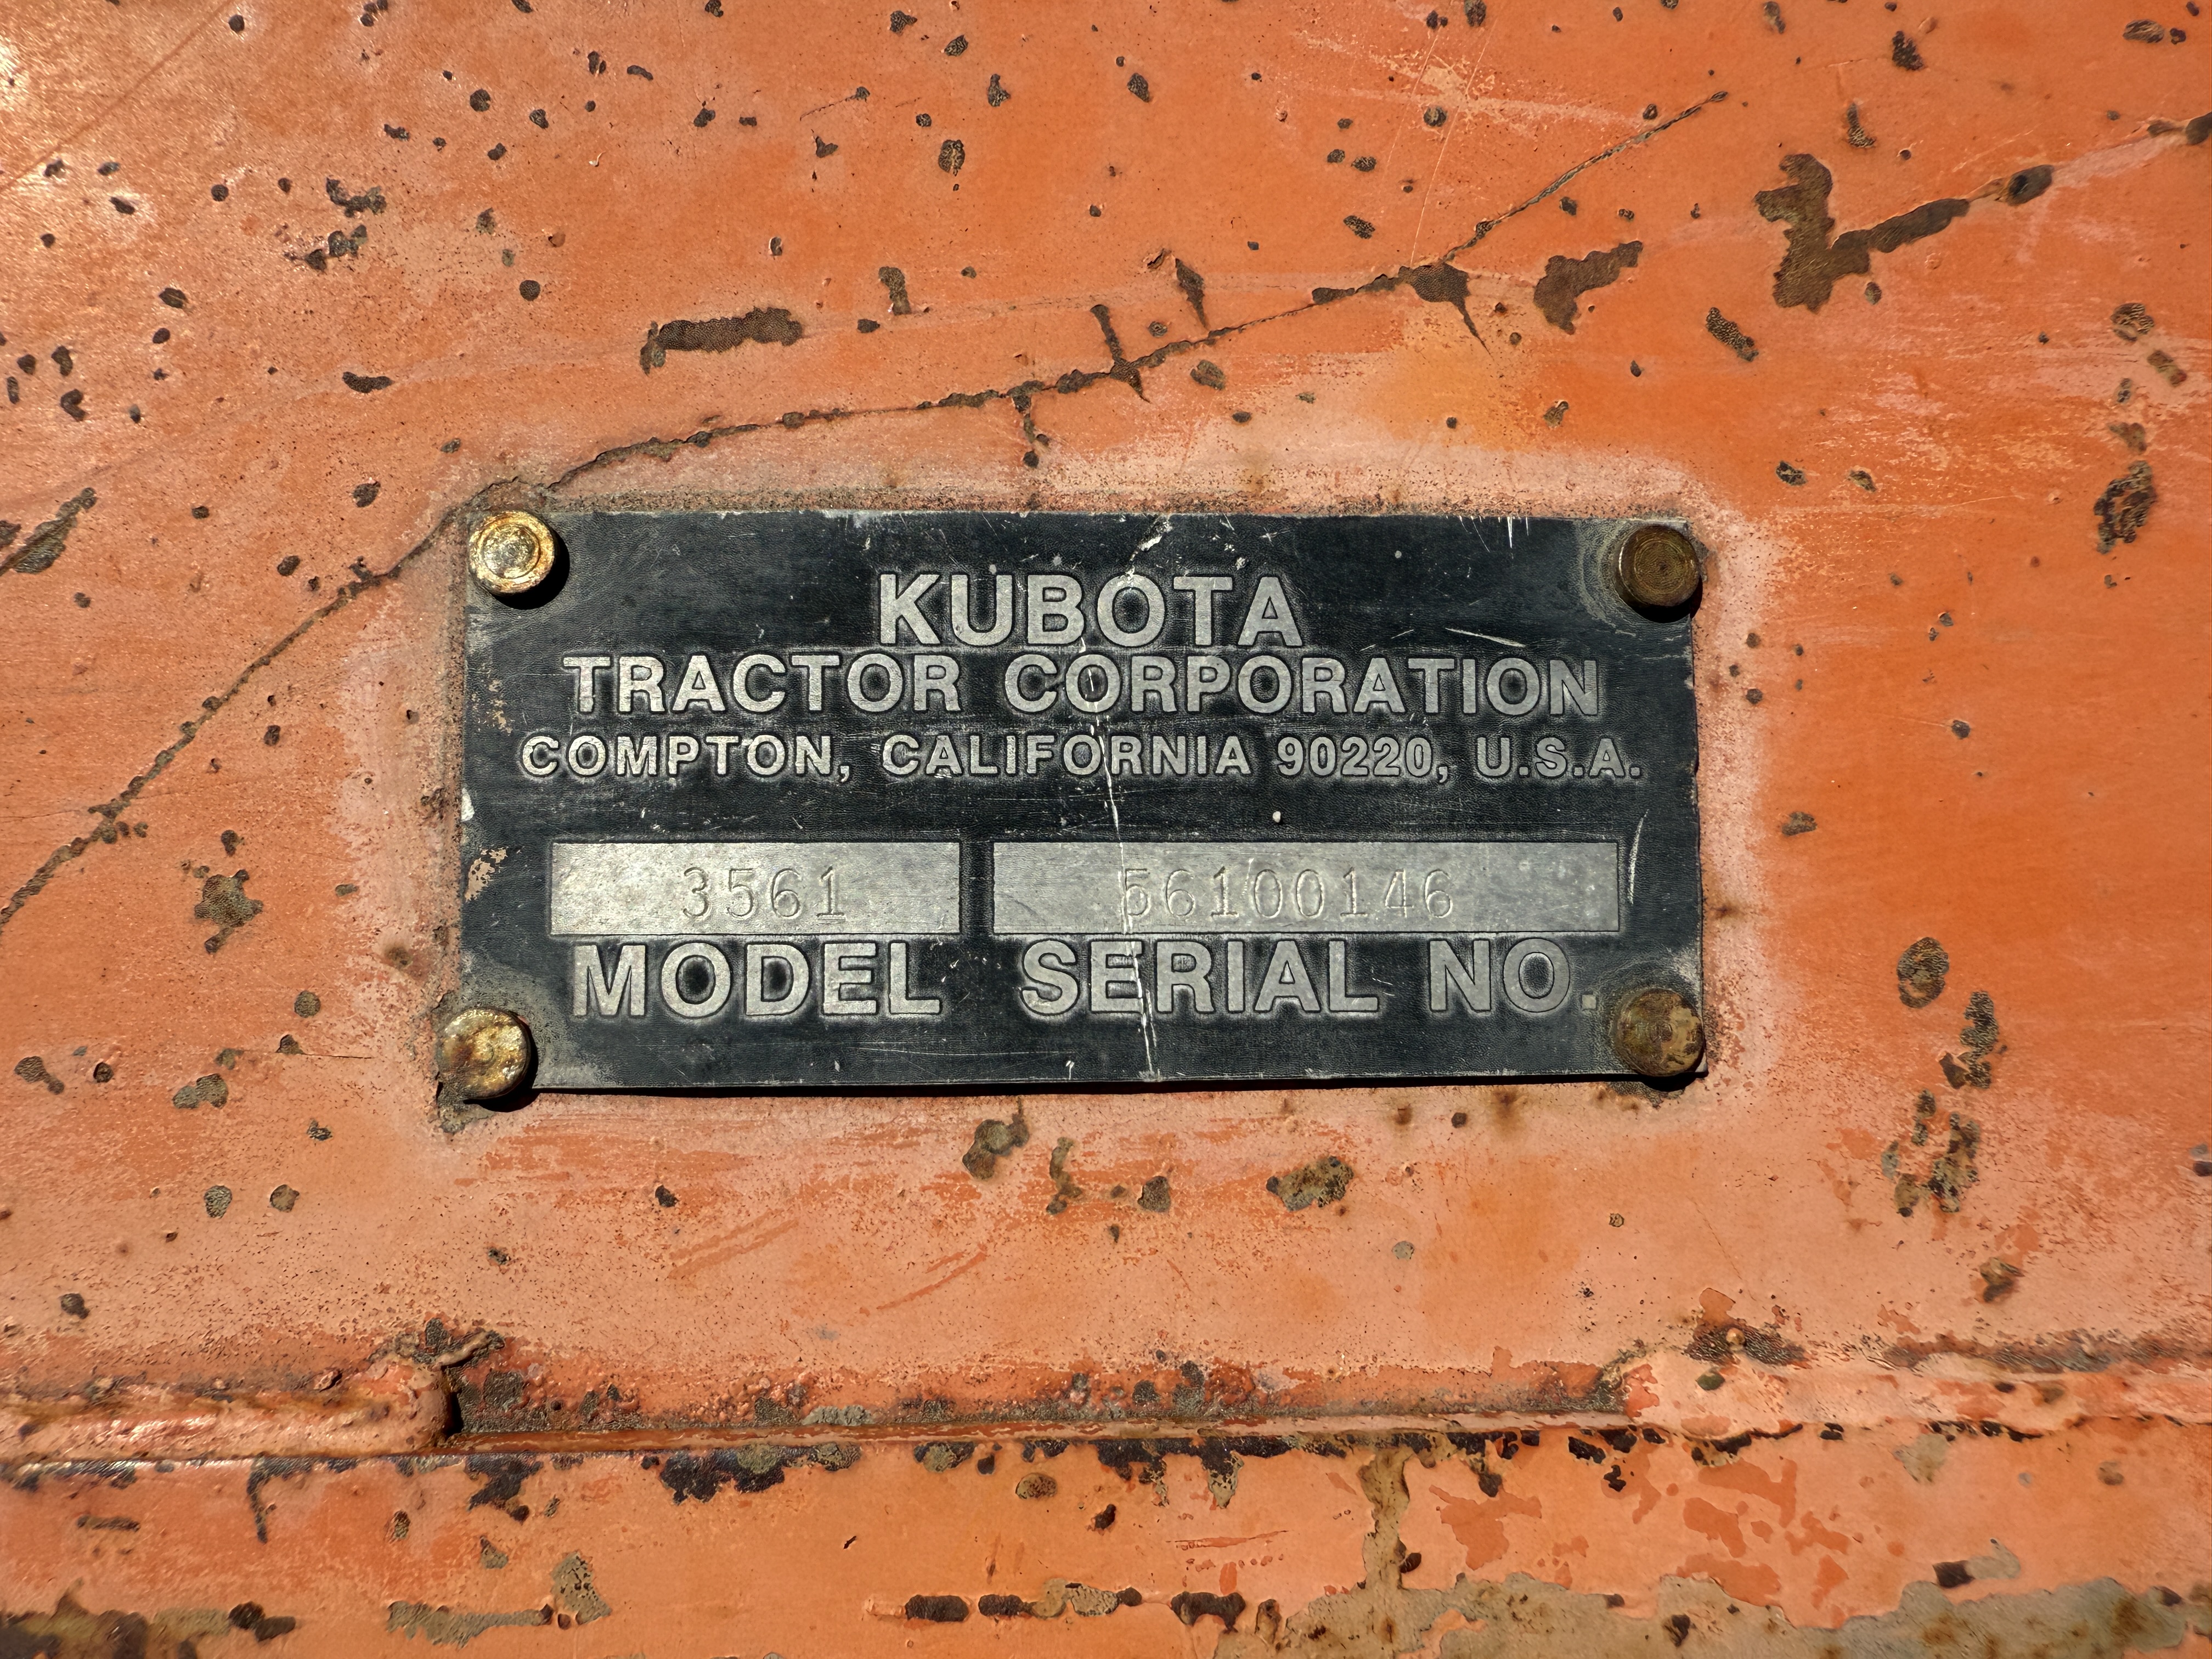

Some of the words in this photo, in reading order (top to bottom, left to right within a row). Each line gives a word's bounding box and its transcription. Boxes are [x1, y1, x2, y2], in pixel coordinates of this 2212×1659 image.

[880, 572, 1303, 647] KUBOTA
[563, 654, 961, 714] TRACTOR
[1005, 654, 1599, 715] CORPORATION
[522, 735, 850, 782] COMPTON,
[882, 735, 1251, 776] CALIFORNIA
[1277, 736, 1449, 782] 90220,
[1476, 736, 1641, 778] U.S.A.
[682, 865, 846, 923] 3561
[1122, 865, 1454, 919] 56100146
[573, 940, 942, 1018] MODEL
[1021, 939, 1379, 1015] SERIAL
[1429, 937, 1598, 1013] NO.
